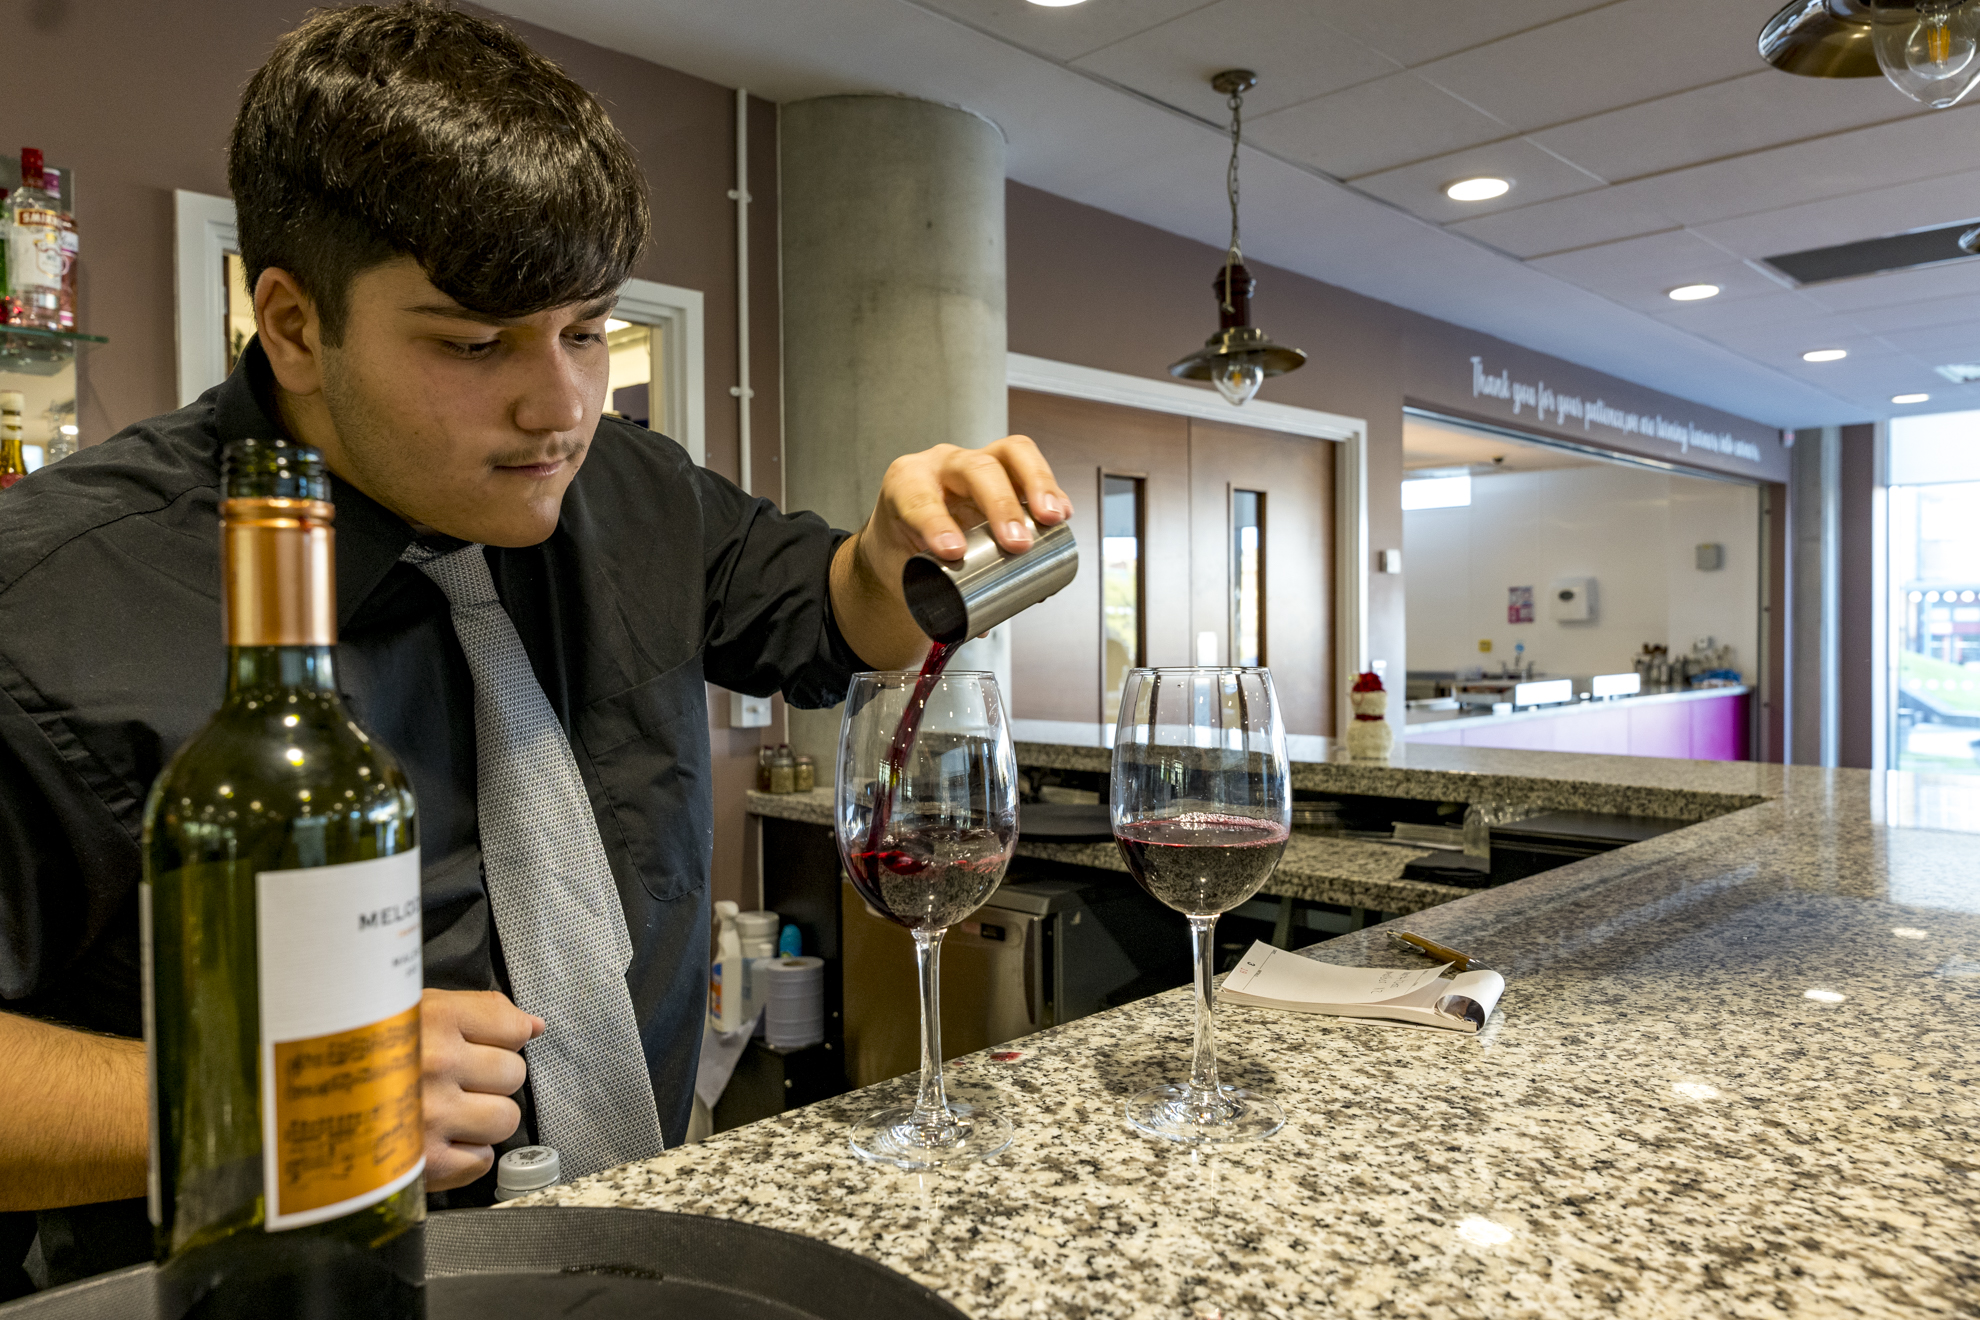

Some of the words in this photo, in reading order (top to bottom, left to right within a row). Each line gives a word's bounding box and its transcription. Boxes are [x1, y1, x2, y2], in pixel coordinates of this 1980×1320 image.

[1469, 356, 1511, 399] Thank
[1512, 381, 1536, 414] you
[1537, 380, 1555, 421] for
[1557, 394, 1583, 425] your
